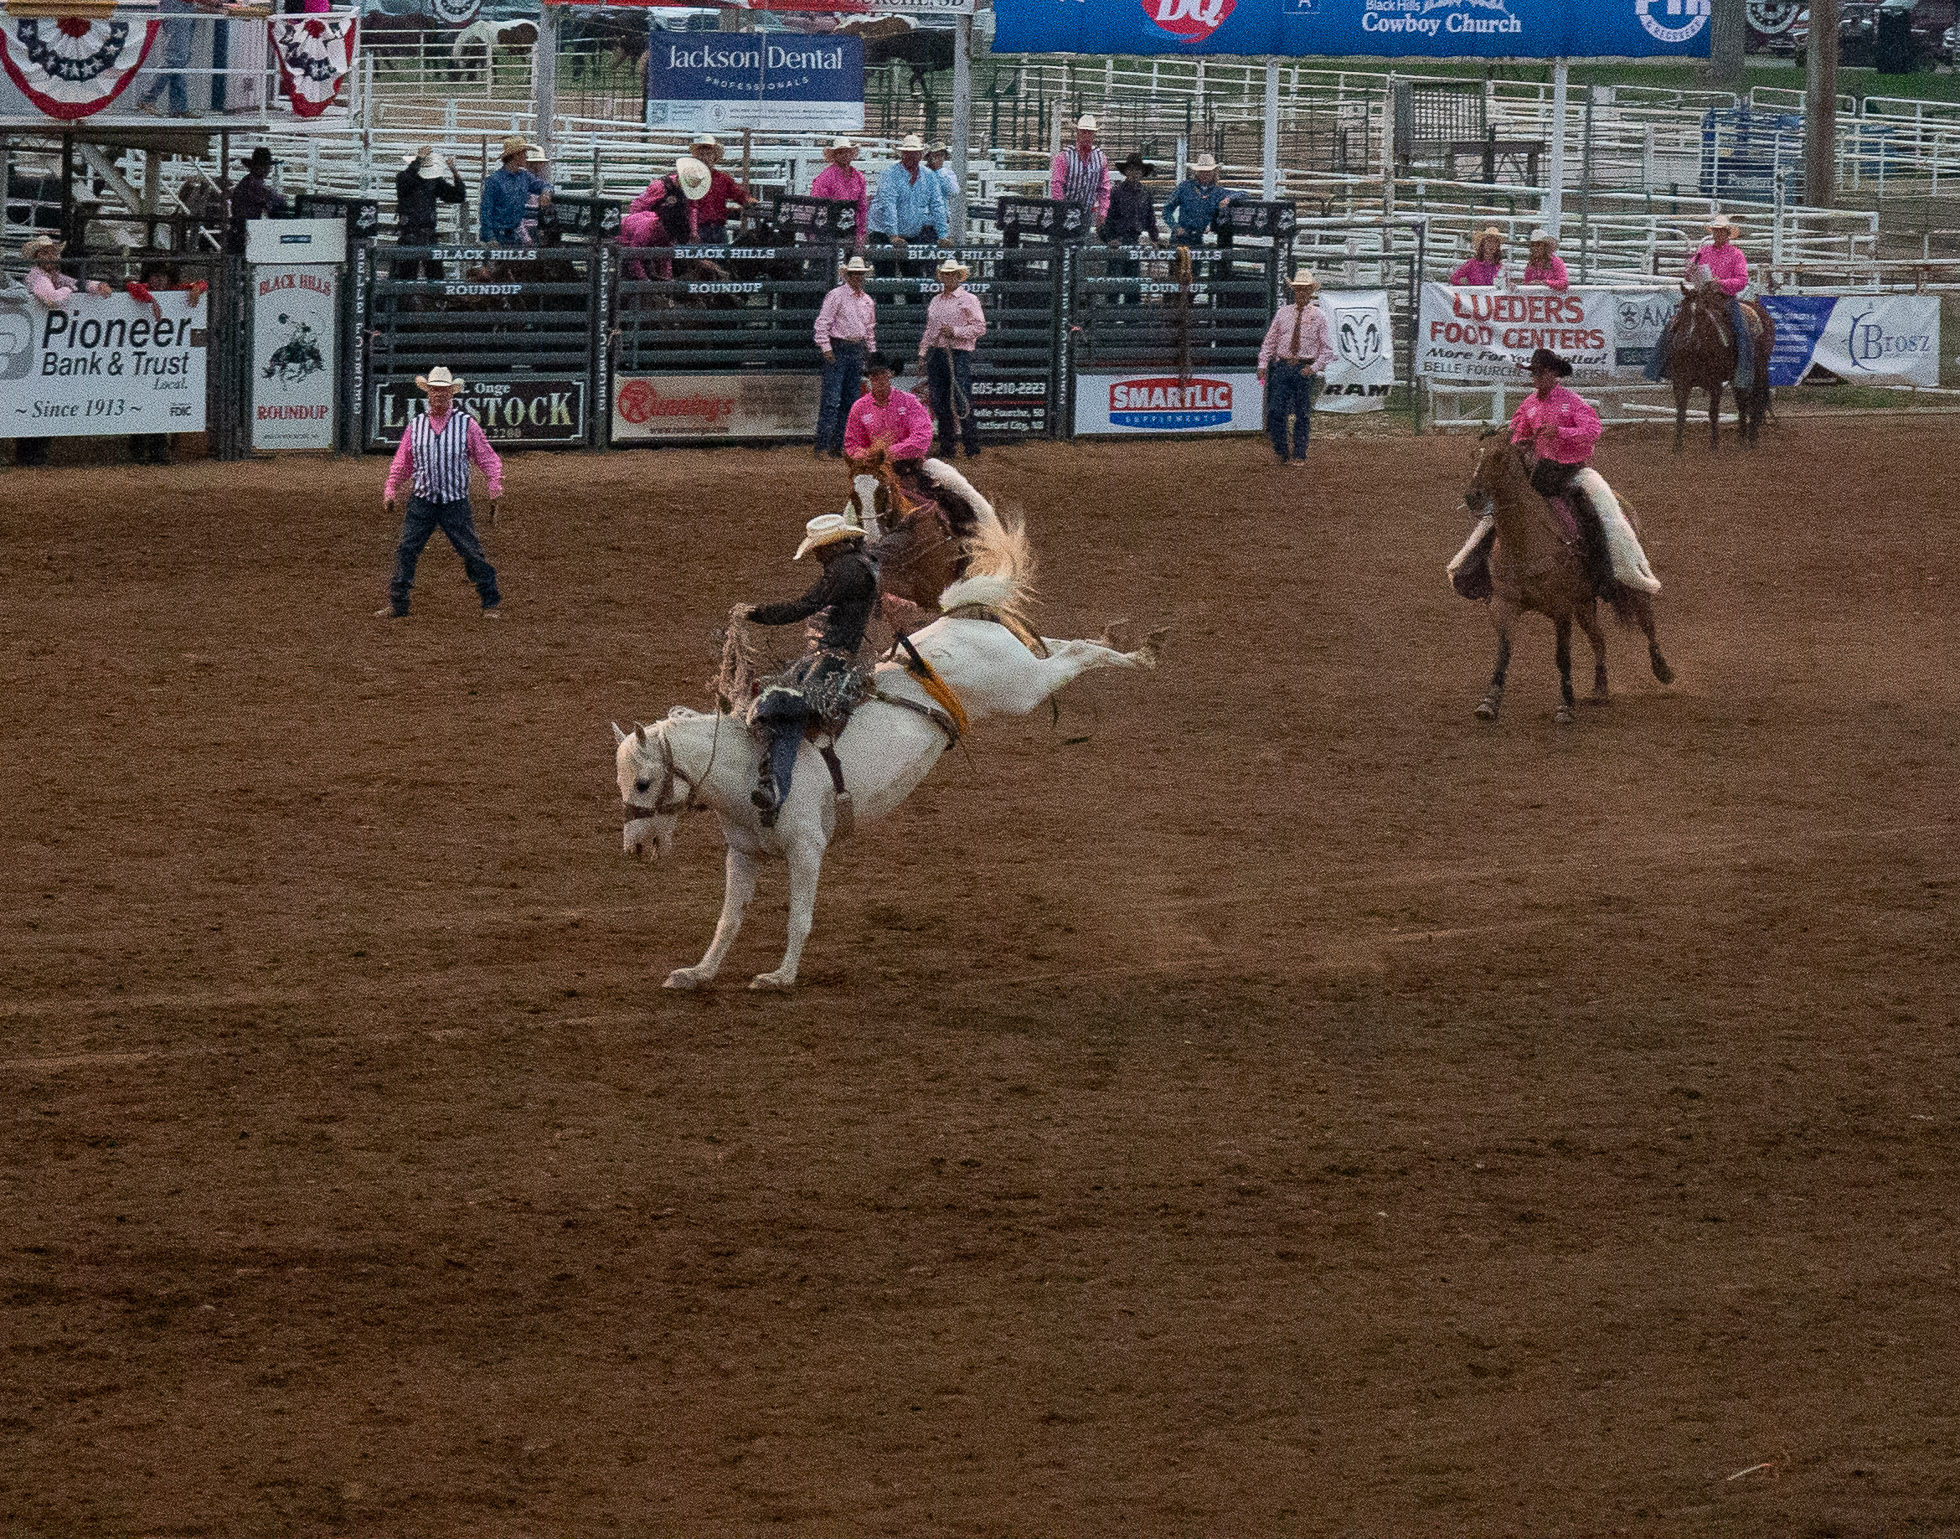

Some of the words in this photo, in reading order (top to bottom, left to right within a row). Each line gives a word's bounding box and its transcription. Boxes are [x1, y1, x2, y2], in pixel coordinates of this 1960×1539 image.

[1362, 13, 1442, 36] Cowboy
[1445, 13, 1522, 33] Church
[667, 46, 760, 69] Jackson
[768, 46, 842, 69] Dental
[704, 75, 810, 91] PROFESSIONALS
[432, 250, 486, 260] BLACK
[490, 250, 537, 260] HILLS
[674, 249, 726, 259] BLACK
[730, 249, 776, 259] HILLS
[908, 250, 956, 260] BLACK
[961, 250, 1005, 260] HILLS
[1129, 250, 1177, 260] BLACK
[1189, 250, 1222, 260] ILLS
[259, 274, 296, 296] BLACK
[300, 274, 331, 296] HILLS
[445, 284, 523, 295] ROUNDUP
[690, 282, 764, 293] ROUNDUP
[920, 283, 991, 293] RODUP
[1140, 283, 1208, 293] ROUNUP
[1453, 292, 1585, 324] LUEDERS
[42, 310, 192, 349] Pioneer
[1430, 321, 1493, 346] FOOD
[1502, 328, 1606, 350] CENTERS
[1859, 324, 1932, 360] Brosz
[42, 351, 103, 376] Bank
[107, 351, 124, 376] &
[132, 352, 190, 375] Trust
[1426, 347, 1472, 361] More
[1476, 350, 1508, 362] For
[1510, 353, 1532, 364] You
[1564, 353, 1608, 365] ollar!
[1424, 361, 1462, 373] BELLE
[1466, 363, 1525, 377] FOURCHE
[153, 377, 188, 390] Local.
[474, 382, 511, 397] Onge
[971, 382, 1046, 394] 605-210-2223
[1324, 384, 1392, 397] RAM
[1113, 384, 1230, 409] SMARTLIC
[32, 400, 80, 418] Since
[85, 399, 125, 417] 1913
[169, 405, 192, 417] FDIC
[257, 405, 329, 420] ROUNDUP
